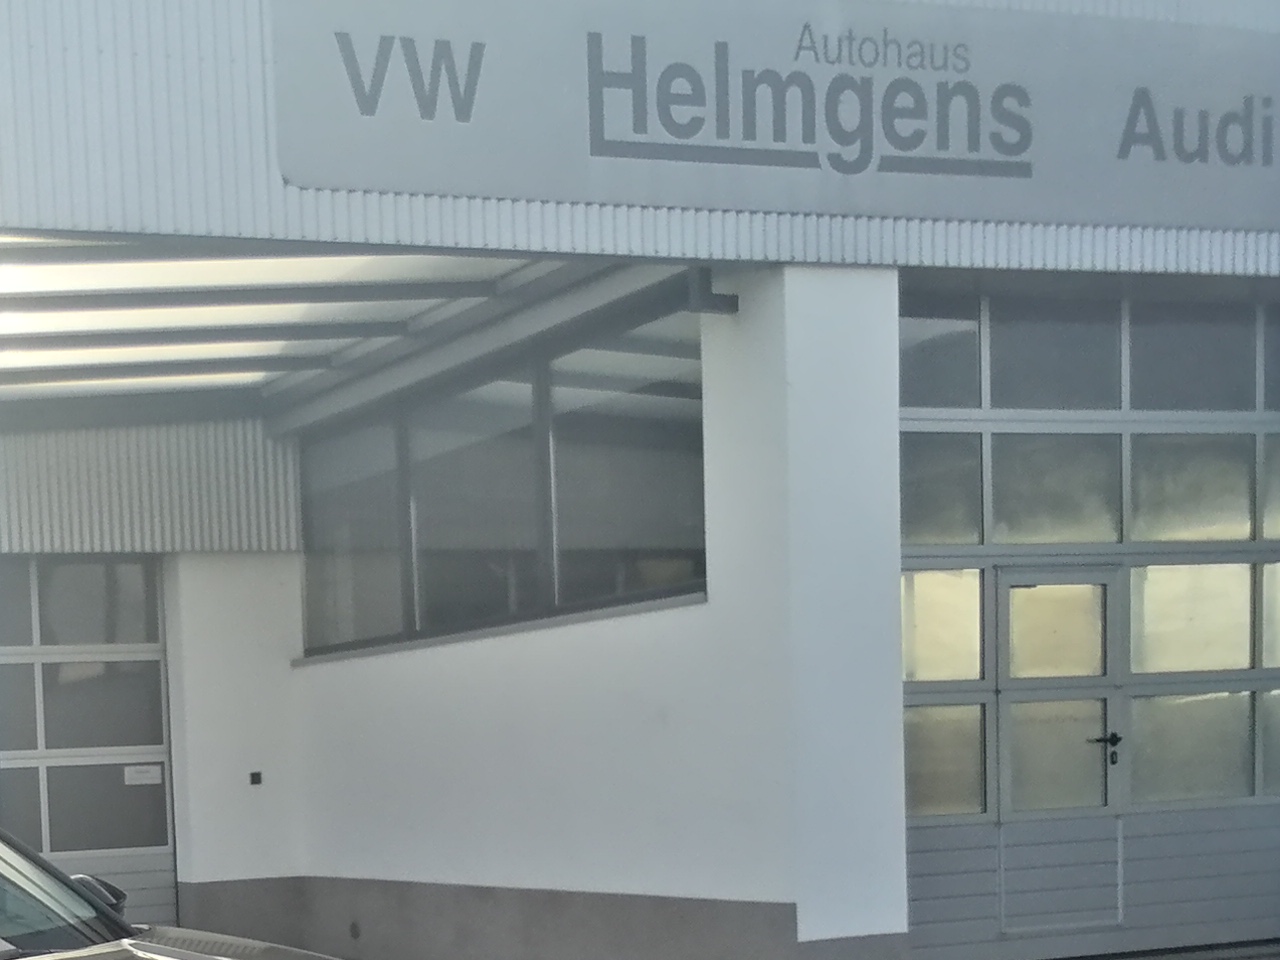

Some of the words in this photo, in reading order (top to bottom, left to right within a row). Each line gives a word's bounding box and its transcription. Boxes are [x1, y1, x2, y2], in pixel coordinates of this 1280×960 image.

[334, 31, 486, 124] VW
[793, 22, 972, 73] Autohaus
[587, 31, 1033, 175] Helmgens
[1116, 86, 1274, 167] Audi
